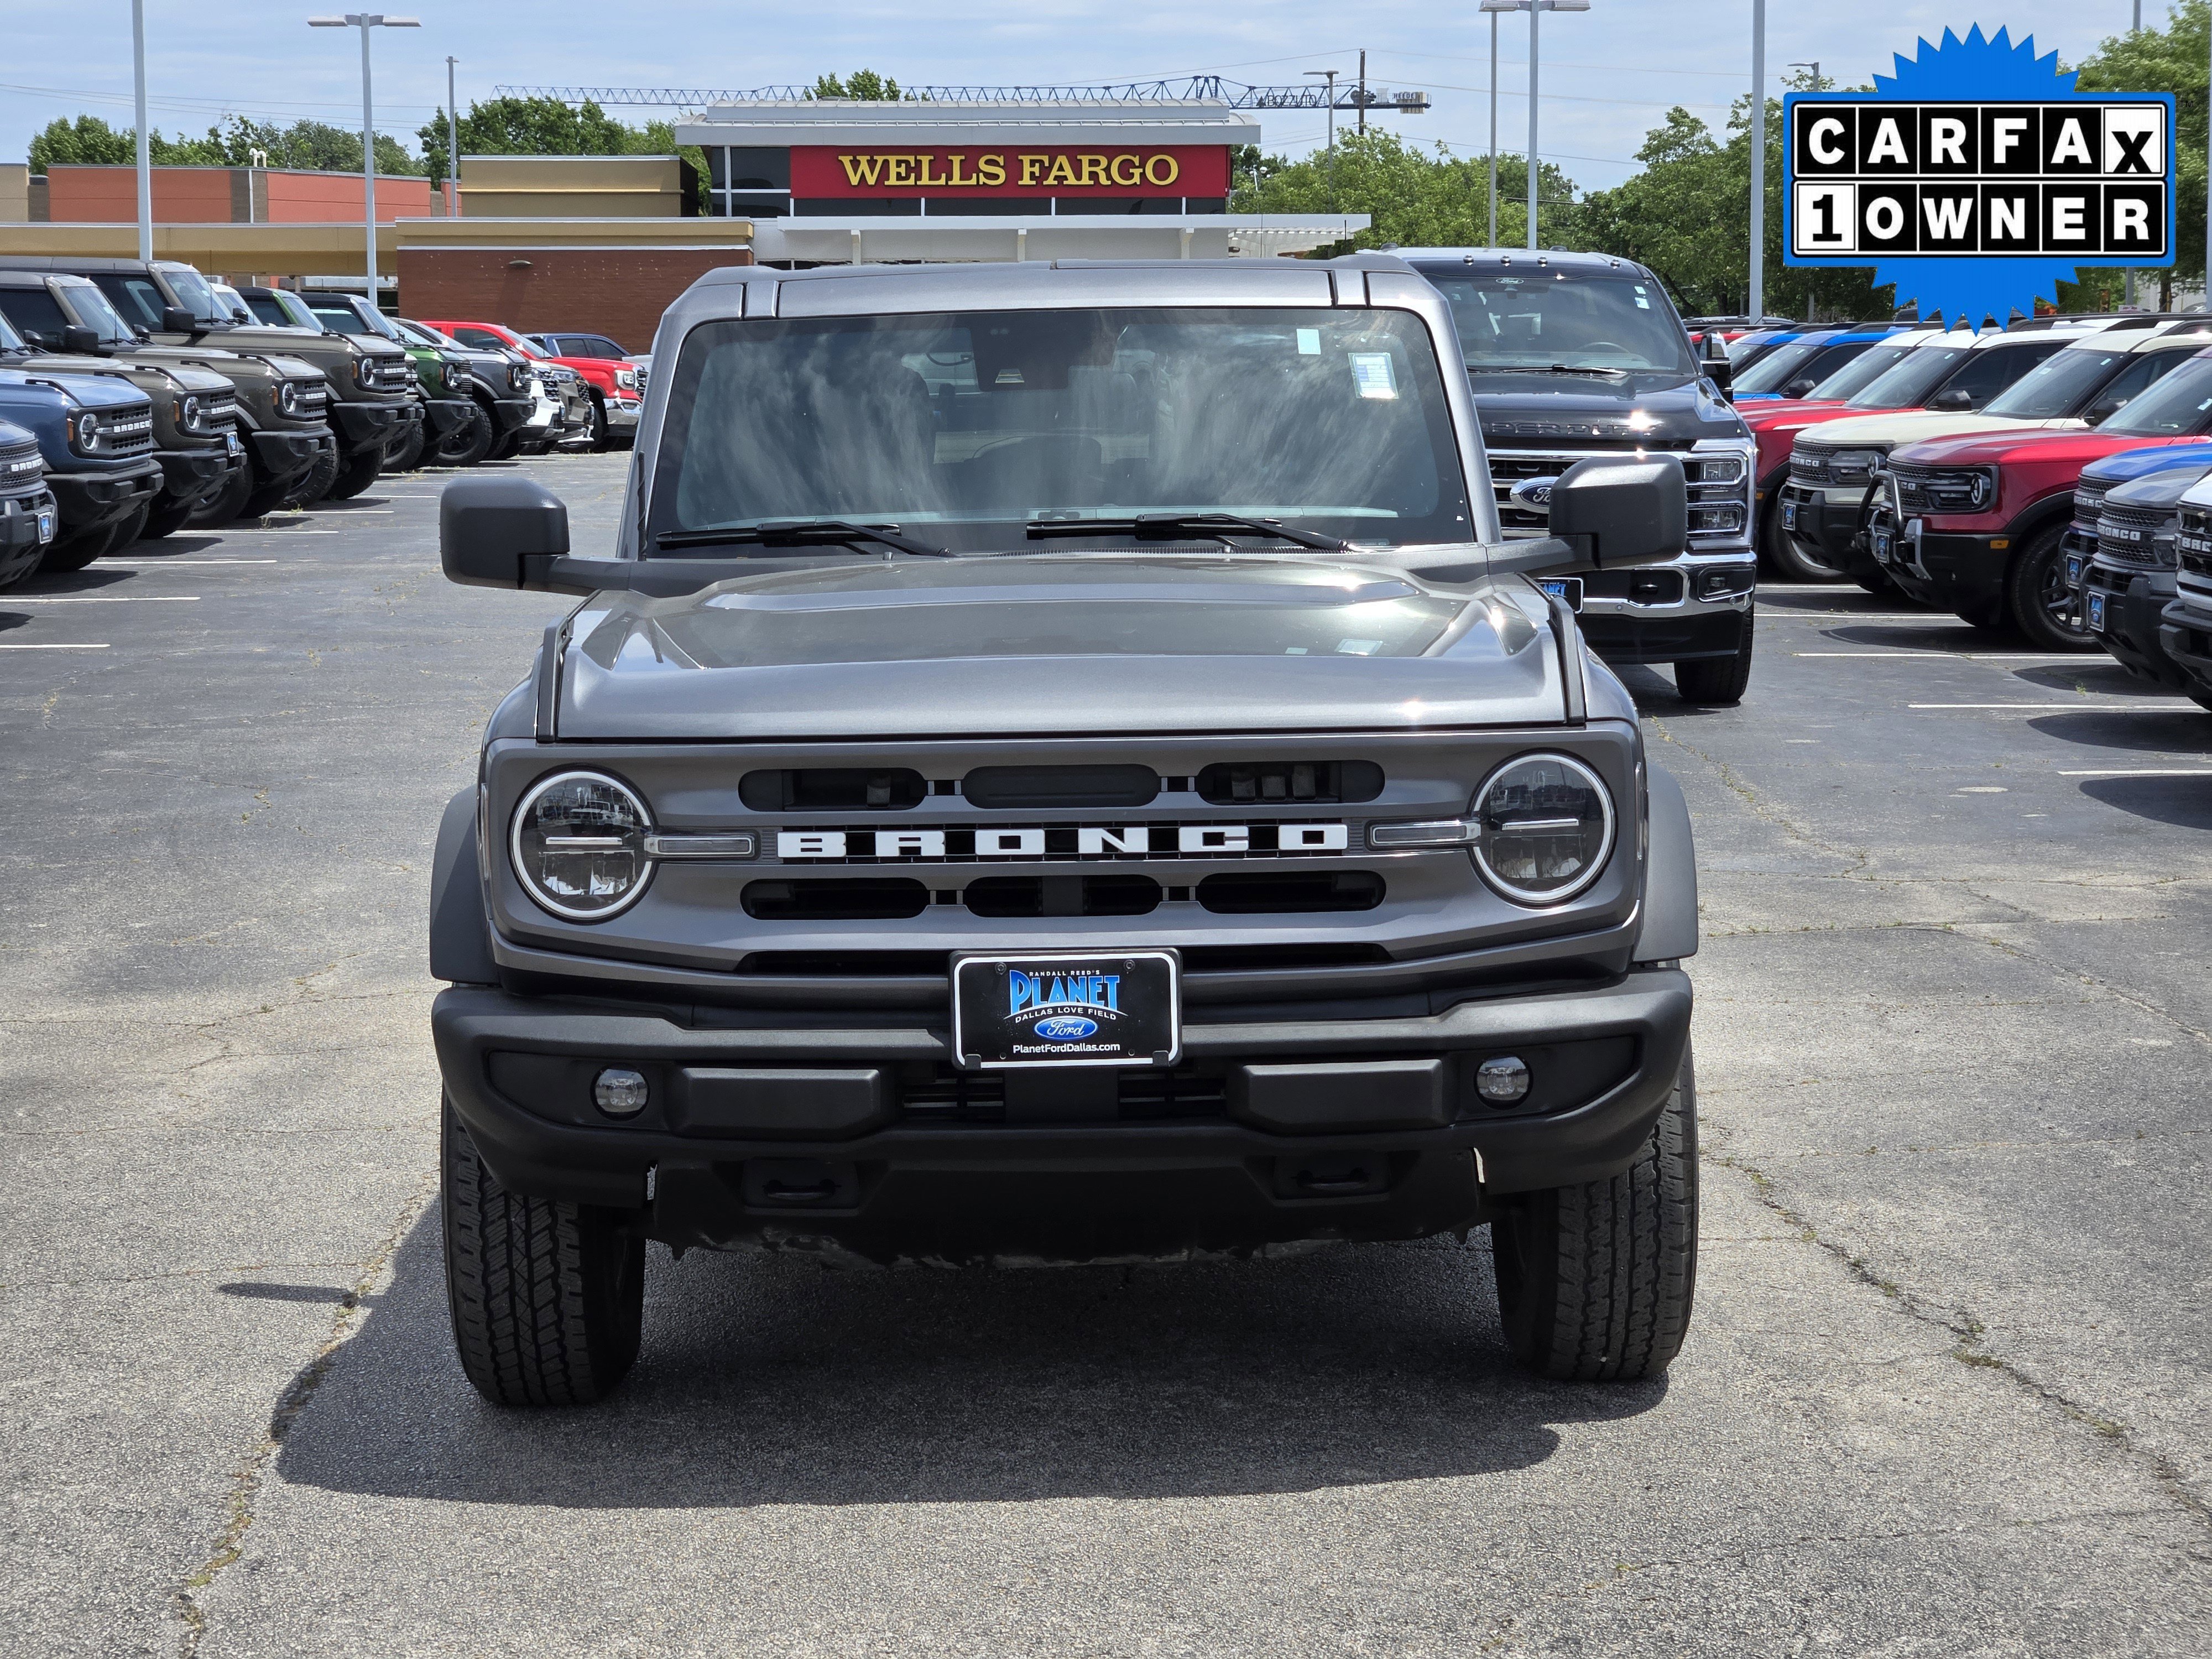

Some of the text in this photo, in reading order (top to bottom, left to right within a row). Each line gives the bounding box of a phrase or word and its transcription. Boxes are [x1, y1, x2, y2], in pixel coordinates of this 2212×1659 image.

[1267, 95, 1317, 106] BOZZUTO
[838, 155, 1178, 185] WELLS FARGO
[777, 823, 1348, 858] BRONCO
[1009, 969, 1120, 1015] PLANET
[1015, 1008, 1053, 1023] DALLAS
[1088, 1009, 1117, 1020] FIELD
[1046, 1020, 1085, 1036] Ford
[1013, 1042, 1120, 1054] PlanetFordDallas.com
